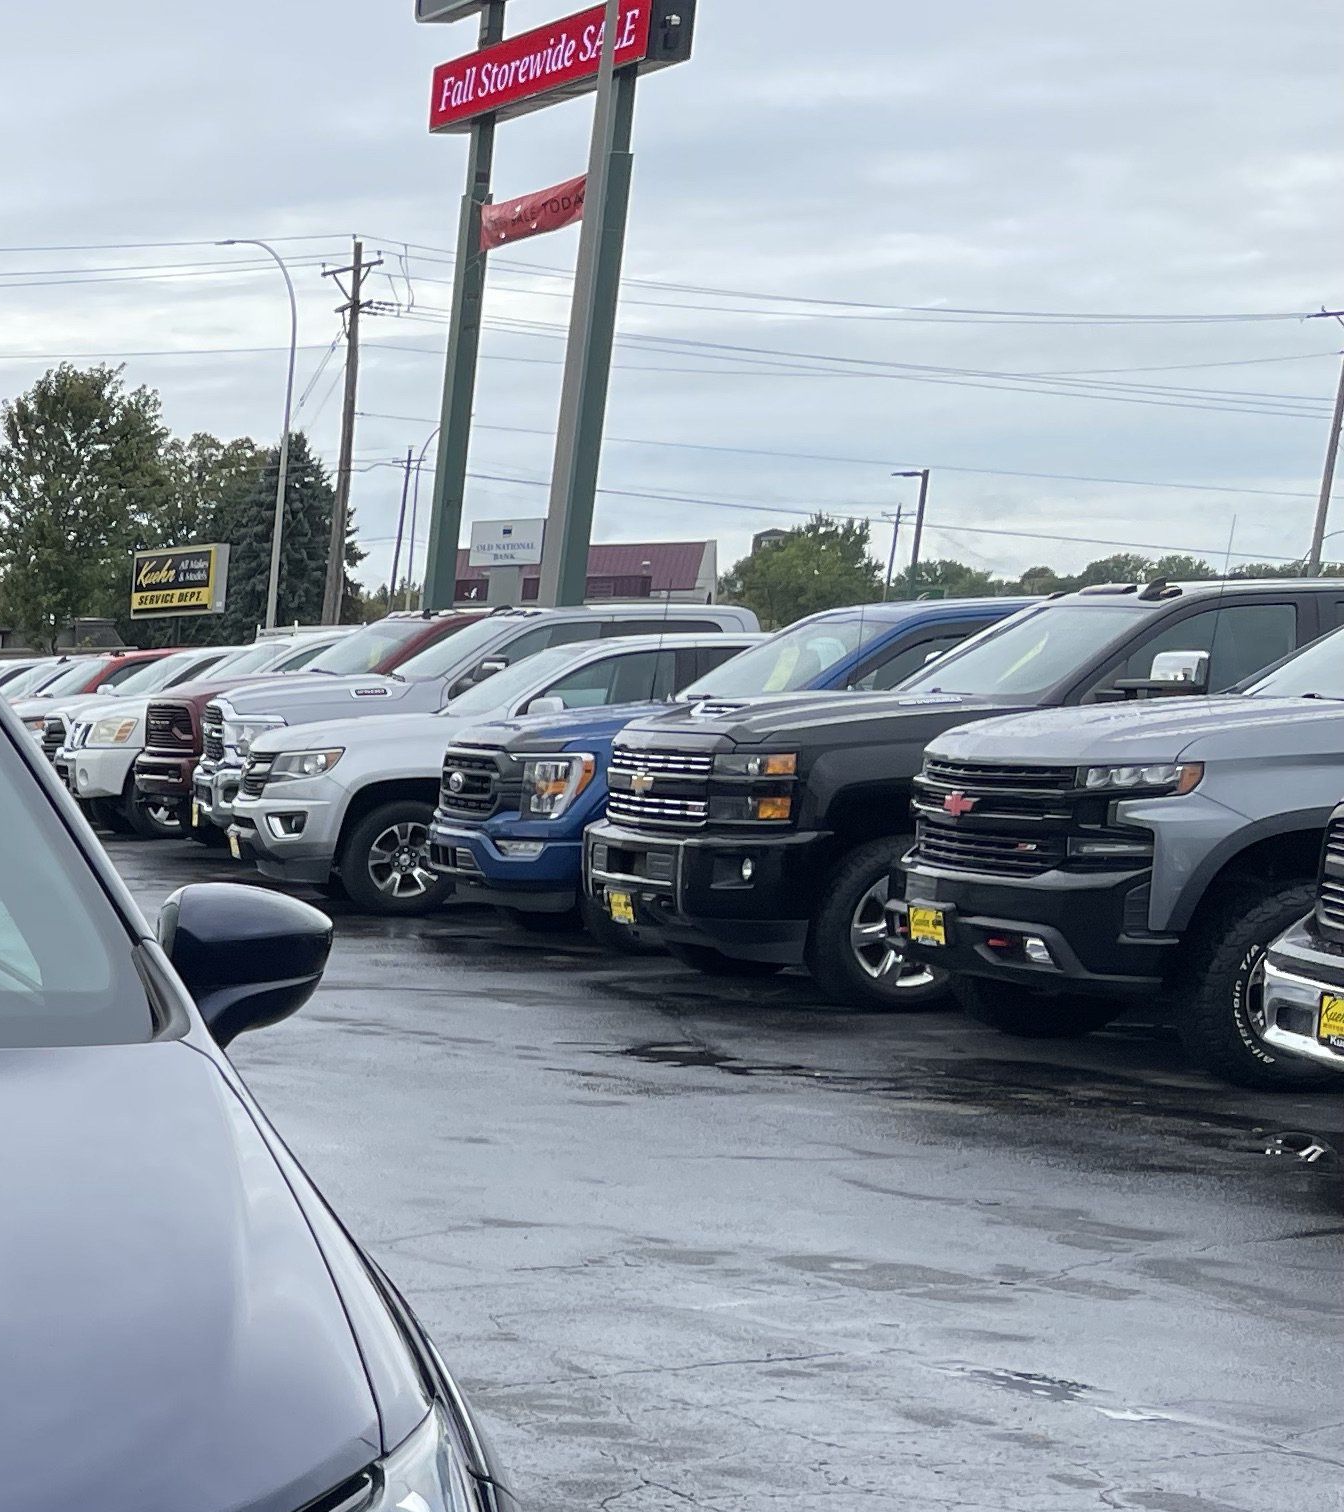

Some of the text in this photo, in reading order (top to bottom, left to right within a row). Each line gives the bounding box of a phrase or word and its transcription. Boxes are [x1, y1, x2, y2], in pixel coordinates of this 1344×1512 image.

[438, 66, 474, 112] Fall
[477, 35, 575, 97] Storewide
[541, 190, 585, 215] TODA
[476, 542, 535, 552] OLD NATIONAL
[493, 553, 516, 561] BANK
[137, 558, 177, 588] Kuehn
[179, 571, 185, 583] &
[138, 590, 203, 606] SERVICE DEPT.
[1320, 998, 1344, 1022] Kue
